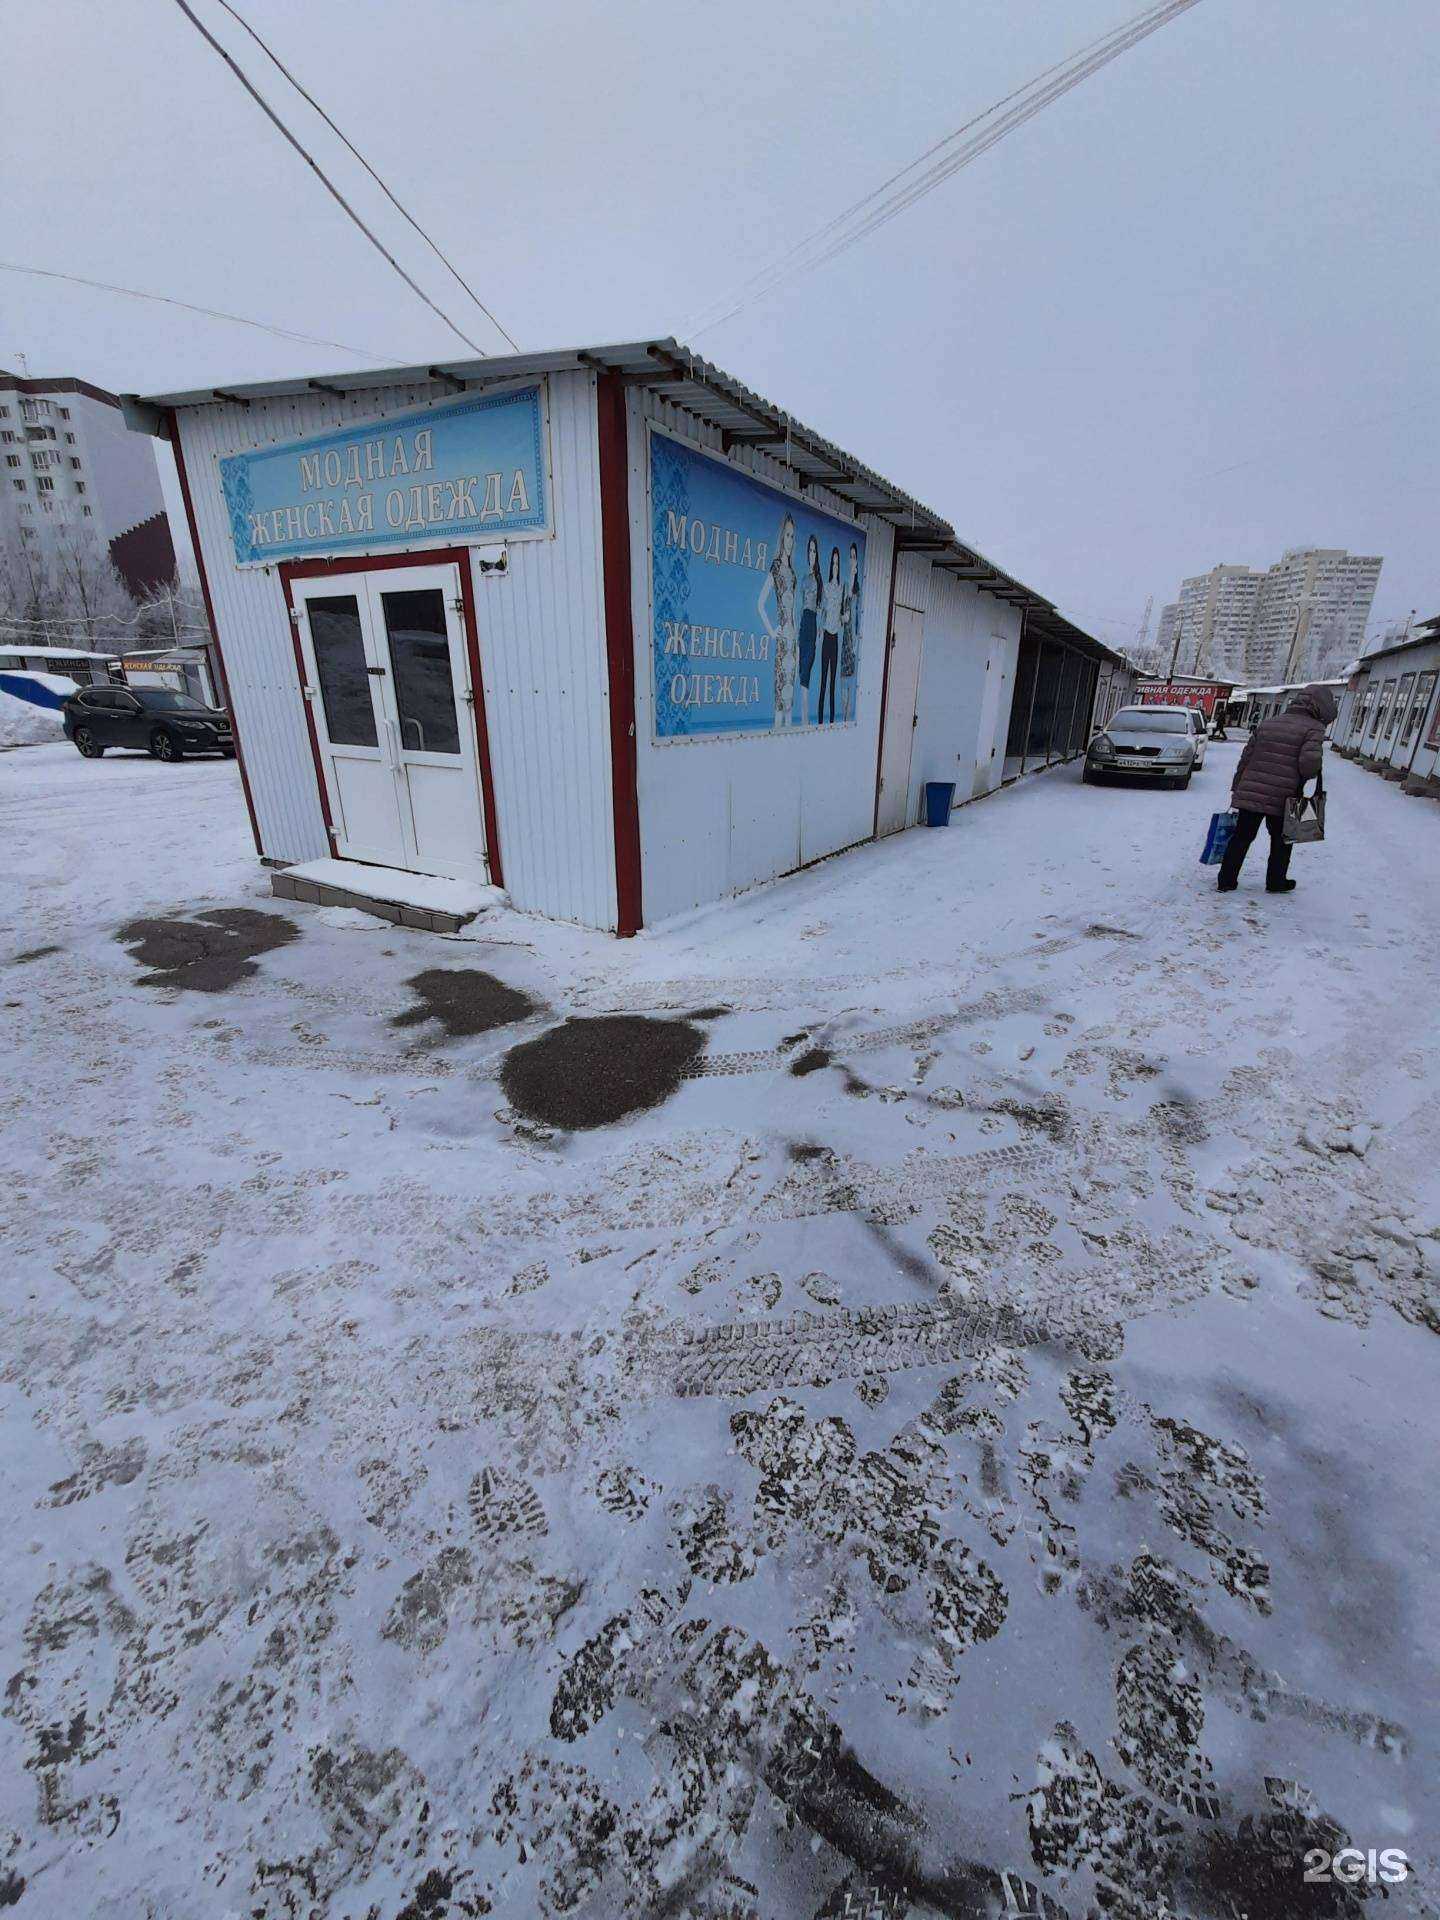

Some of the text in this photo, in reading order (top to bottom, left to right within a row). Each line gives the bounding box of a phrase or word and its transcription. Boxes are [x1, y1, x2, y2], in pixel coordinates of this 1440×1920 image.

[300, 428, 434, 491] МОДНАЯ
[249, 469, 530, 545] ЖЕНСКАЯ ОДЕЖДА
[665, 509, 768, 571] МОДНАЯ
[664, 621, 769, 661] ЖЕНСКАЯ
[670, 673, 760, 708] ОДЕЖДА
[1170, 687, 1212, 695] ОДЕЖДА
